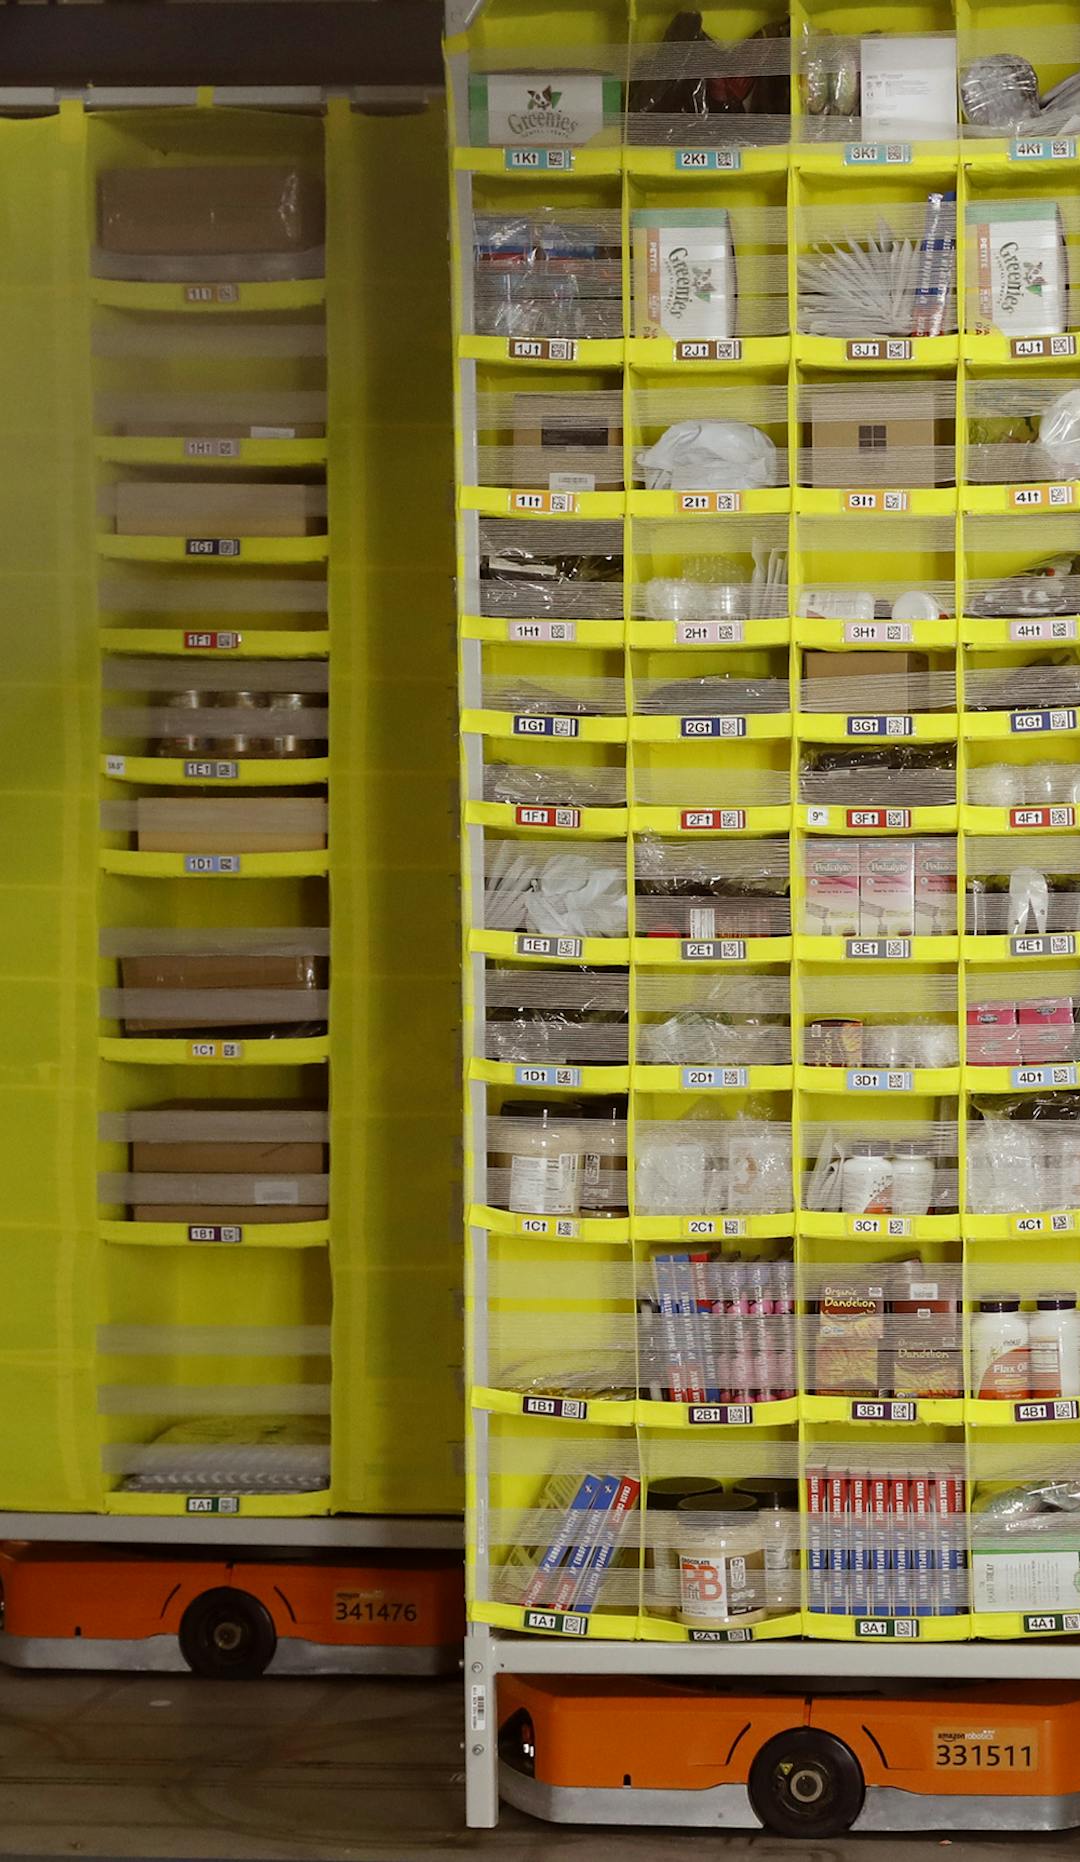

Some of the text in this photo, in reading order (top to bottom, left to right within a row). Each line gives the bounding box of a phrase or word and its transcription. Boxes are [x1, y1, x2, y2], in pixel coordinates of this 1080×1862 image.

[508, 109, 578, 135] Greenies
[853, 148, 870, 159] 3K
[1017, 144, 1034, 155] 4K
[514, 154, 530, 164] 1K
[682, 154, 700, 165] 2K
[668, 247, 692, 319] Greenies
[999, 242, 1024, 314] Greenies
[518, 343, 532, 356] 1J
[684, 345, 700, 356] 2J
[854, 345, 870, 356] 3J
[1018, 342, 1034, 353] 4J
[518, 496, 532, 507] 1I
[684, 497, 699, 508] 2I
[851, 496, 866, 507] 3I
[1016, 492, 1031, 503] 4I
[517, 626, 533, 637] 1H
[685, 628, 700, 639] 2H
[853, 628, 868, 638] 3H
[1018, 625, 1033, 636] 4H
[521, 721, 536, 732] 1G
[687, 722, 703, 733] 2G
[853, 721, 870, 732] 3G
[1017, 717, 1034, 728] 4G
[189, 765, 204, 775] 1E
[524, 811, 539, 822] 1F
[689, 814, 703, 826] 2F
[855, 813, 870, 824] 3F
[1018, 812, 1033, 823] 4F
[191, 859, 205, 869] 1D
[527, 940, 542, 951] 1E
[689, 944, 705, 955] 2E
[855, 944, 870, 955] 3E
[1018, 940, 1034, 951] 4E
[193, 1045, 208, 1055] 1C
[525, 1071, 539, 1082] 1D
[690, 1072, 706, 1083] 2D
[855, 1075, 870, 1086] 3D
[1019, 1072, 1035, 1083] 4D
[524, 1221, 540, 1232] 1C
[691, 1222, 707, 1233] 2C
[855, 1221, 871, 1232] 3C
[1019, 1220, 1034, 1230] 4C
[194, 1229, 206, 1238] 1B
[824, 1287, 858, 1297] Organic
[824, 1297, 876, 1308] Dandelion
[898, 1349, 950, 1359] Dandelion
[993, 1364, 1015, 1373] Flax
[531, 1401, 546, 1412] 1B
[859, 1406, 876, 1417] 3B
[1022, 1406, 1038, 1417] 4B
[697, 1410, 712, 1421] 2B
[833, 1480, 841, 1496] CRASH
[895, 1483, 903, 1499] CRASH
[939, 1481, 947, 1498] CRASH
[191, 1500, 205, 1509] 1A
[336, 1602, 417, 1622] 341476
[532, 1616, 547, 1627] 1A
[1030, 1618, 1046, 1629] 4A
[862, 1623, 878, 1634] 3A
[936, 1744, 1031, 1767] 331511
